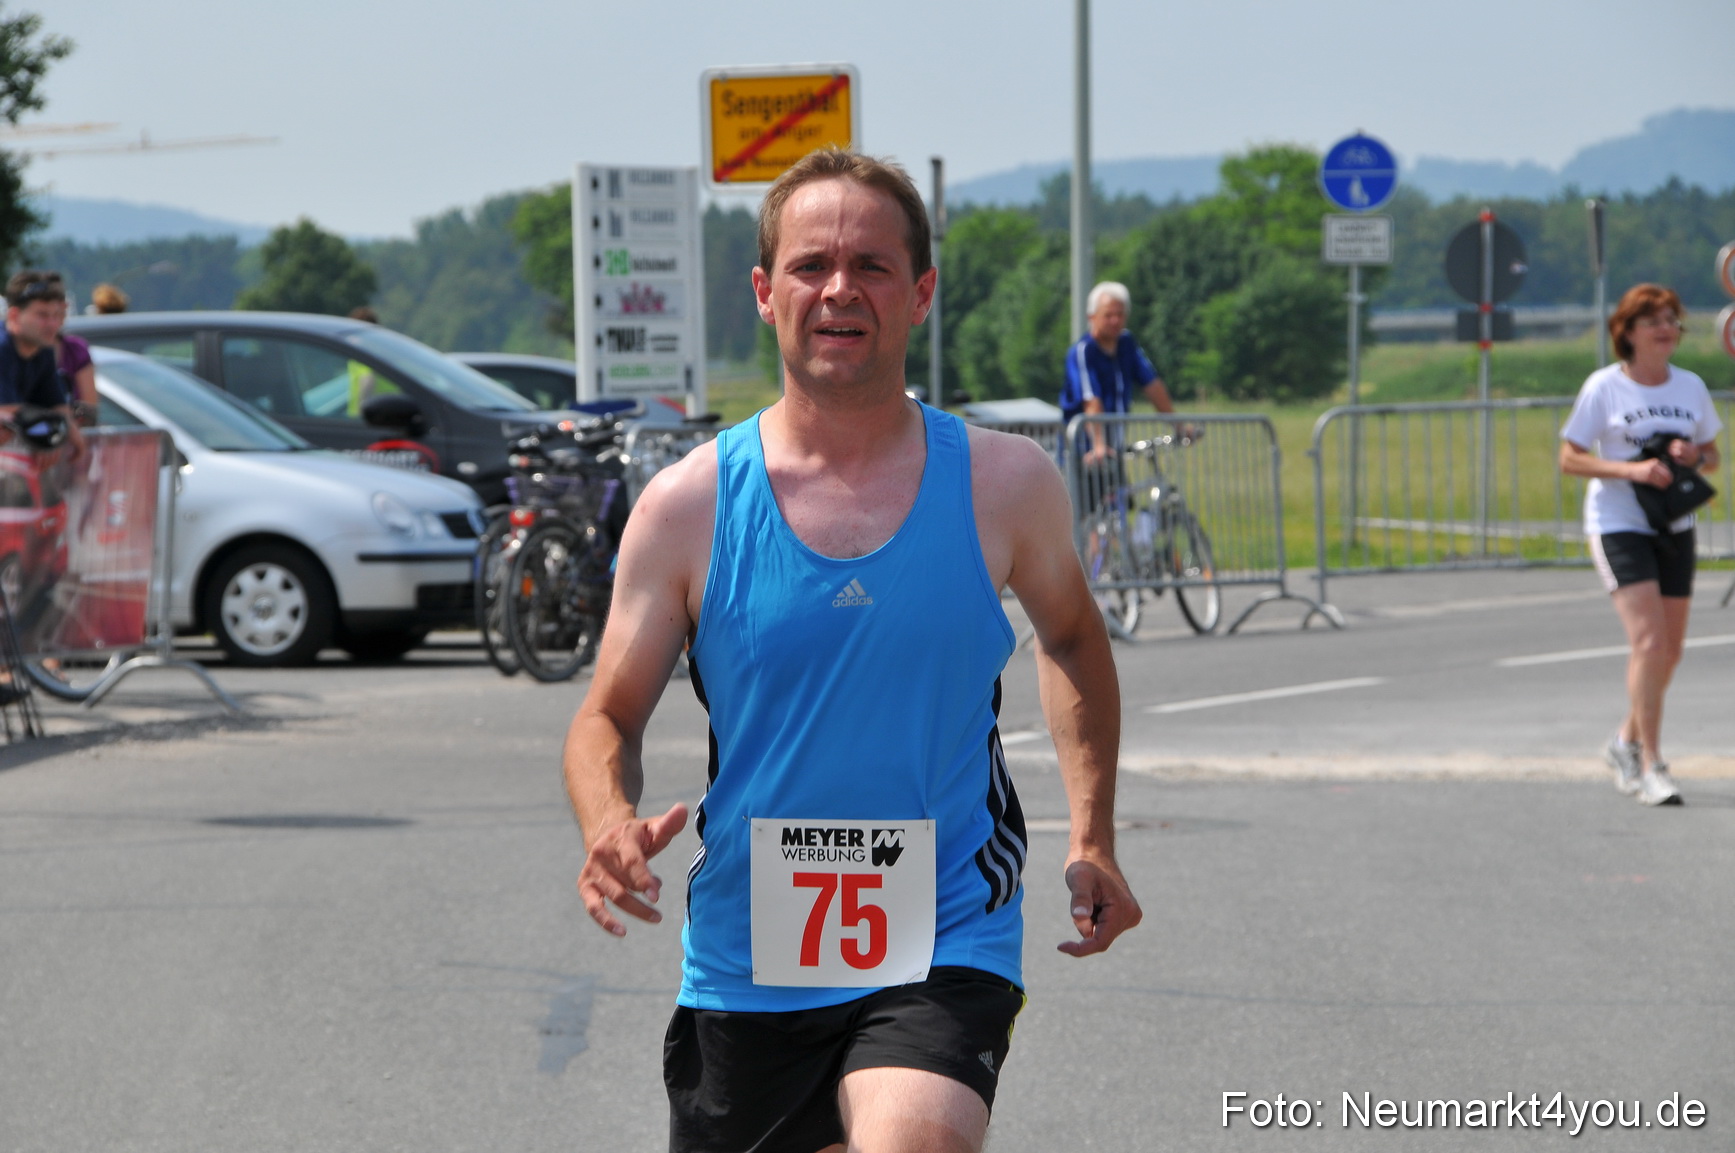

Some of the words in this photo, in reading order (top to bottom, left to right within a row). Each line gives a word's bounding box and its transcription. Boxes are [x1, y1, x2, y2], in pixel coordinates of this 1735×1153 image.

[1624, 405, 1695, 425] BERGER
[832, 596, 873, 608] adidas
[781, 827, 865, 847] MEYER
[781, 847, 866, 863] WERBUNG
[793, 872, 887, 970] 75
